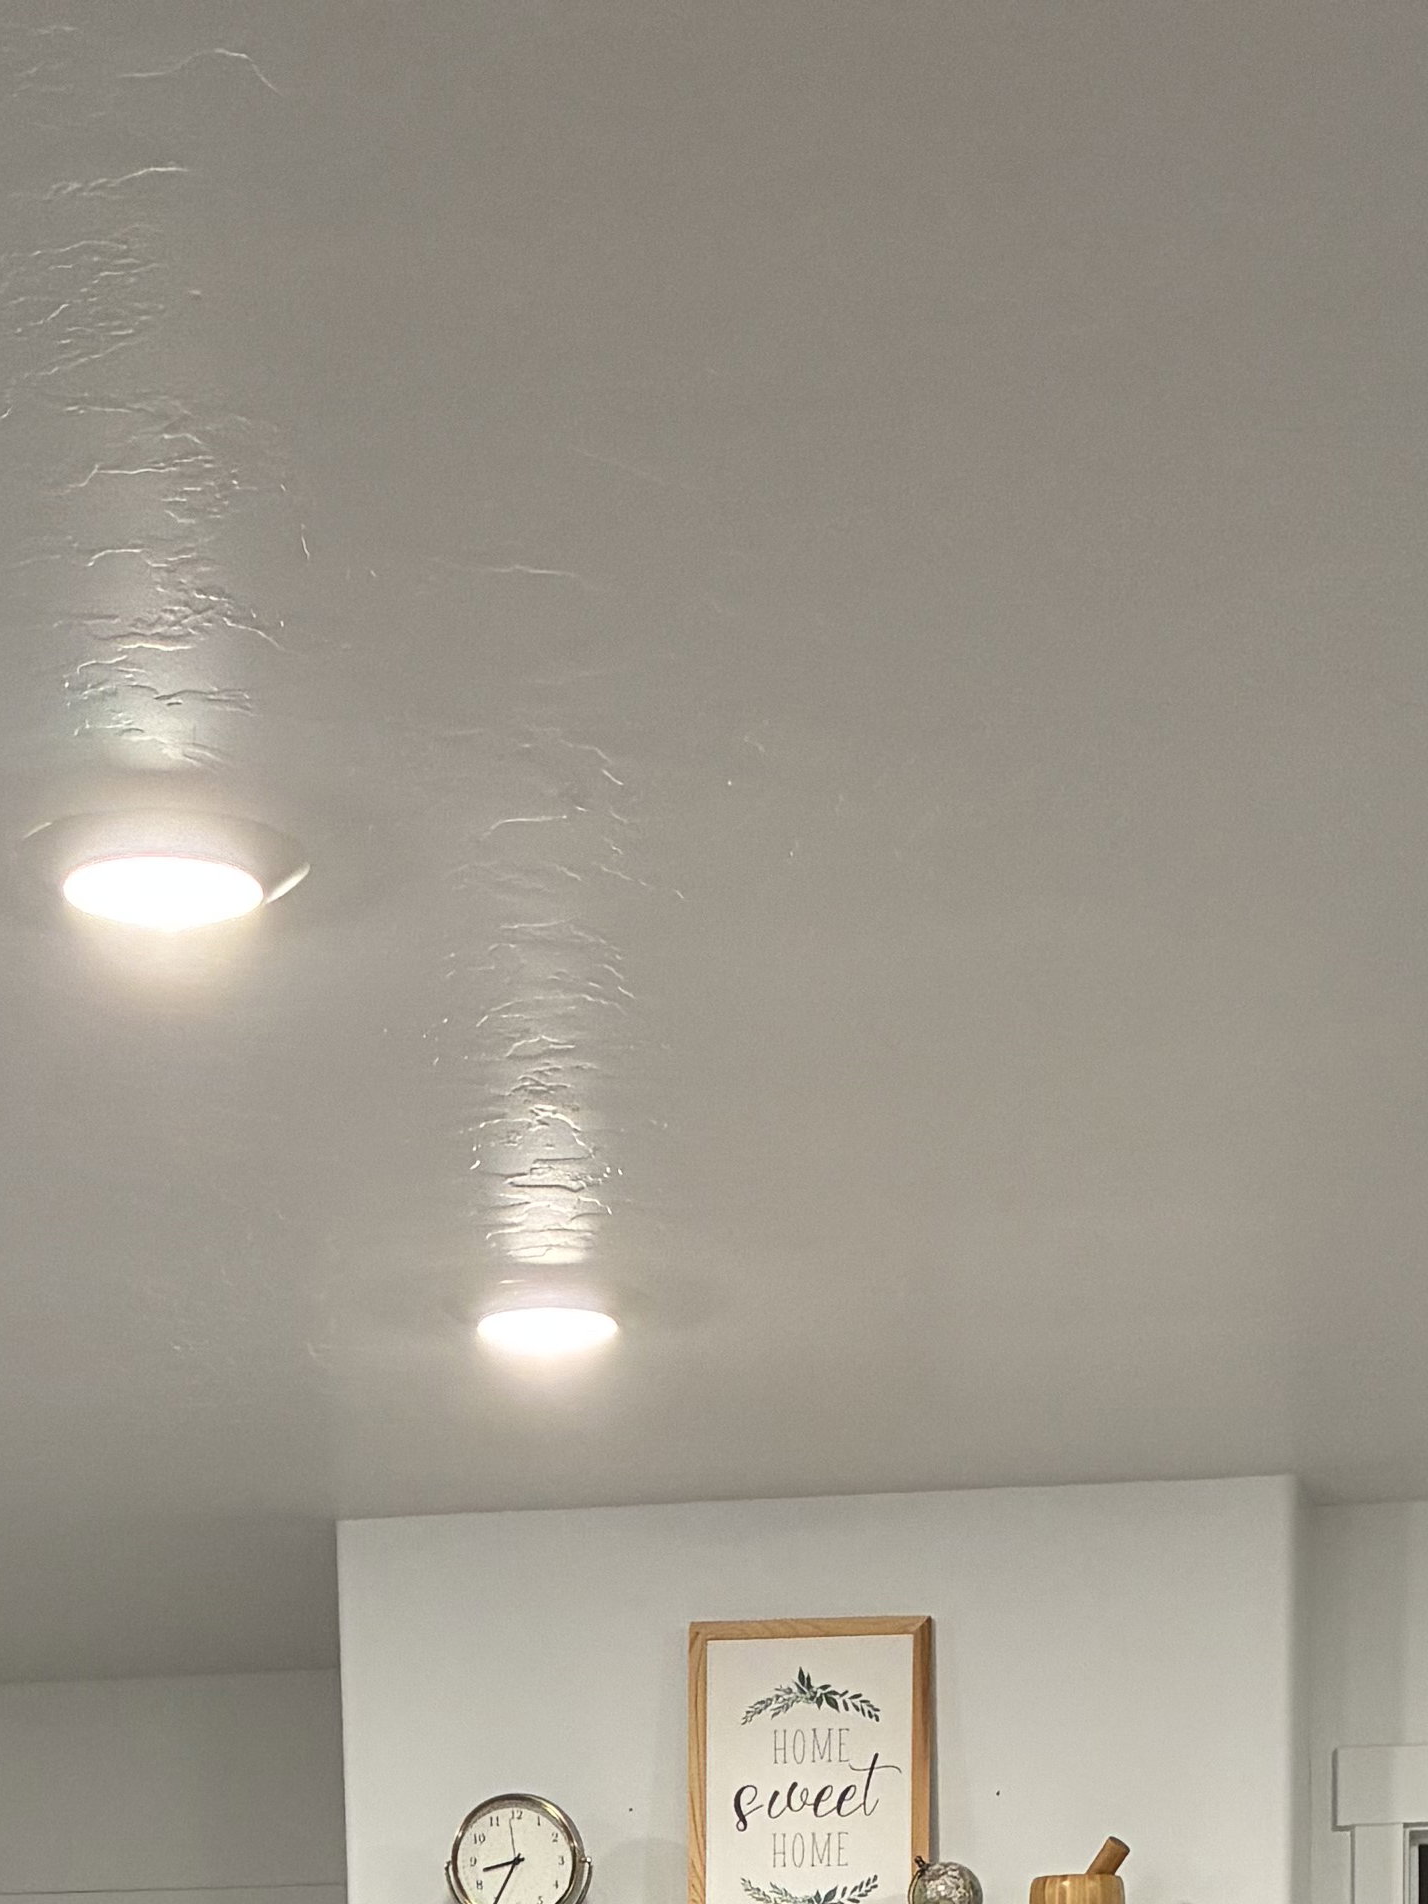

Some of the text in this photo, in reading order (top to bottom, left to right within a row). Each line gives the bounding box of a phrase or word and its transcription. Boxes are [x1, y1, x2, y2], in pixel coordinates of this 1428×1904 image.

[773, 1728, 850, 1764] HOME
[734, 1753, 902, 1832] sweet
[490, 1816, 500, 1827] 11
[511, 1810, 523, 1820] 12
[474, 1833, 486, 1844] 10
[772, 1832, 849, 1868] HOME
